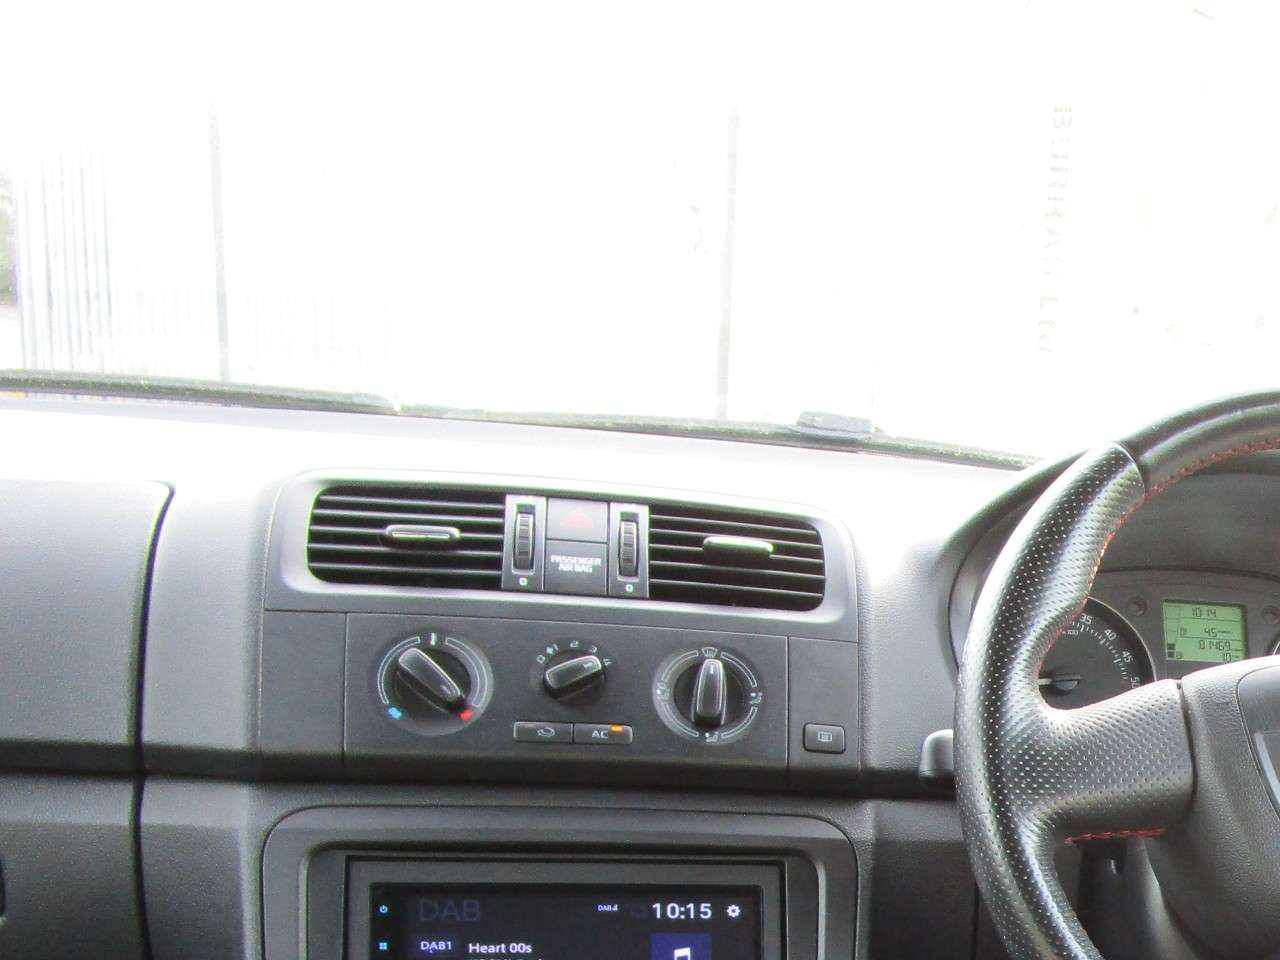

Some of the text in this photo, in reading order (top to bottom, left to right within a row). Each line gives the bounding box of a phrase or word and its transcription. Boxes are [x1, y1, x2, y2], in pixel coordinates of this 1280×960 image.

[1080, 613, 1093, 625] 35
[1104, 629, 1117, 641] 40
[1122, 650, 1133, 663] 45
[591, 730, 609, 739] AC
[418, 899, 481, 922] DAB
[652, 902, 712, 919] 10:15
[420, 940, 452, 951] DAB1
[468, 942, 533, 954] Heart 00s
